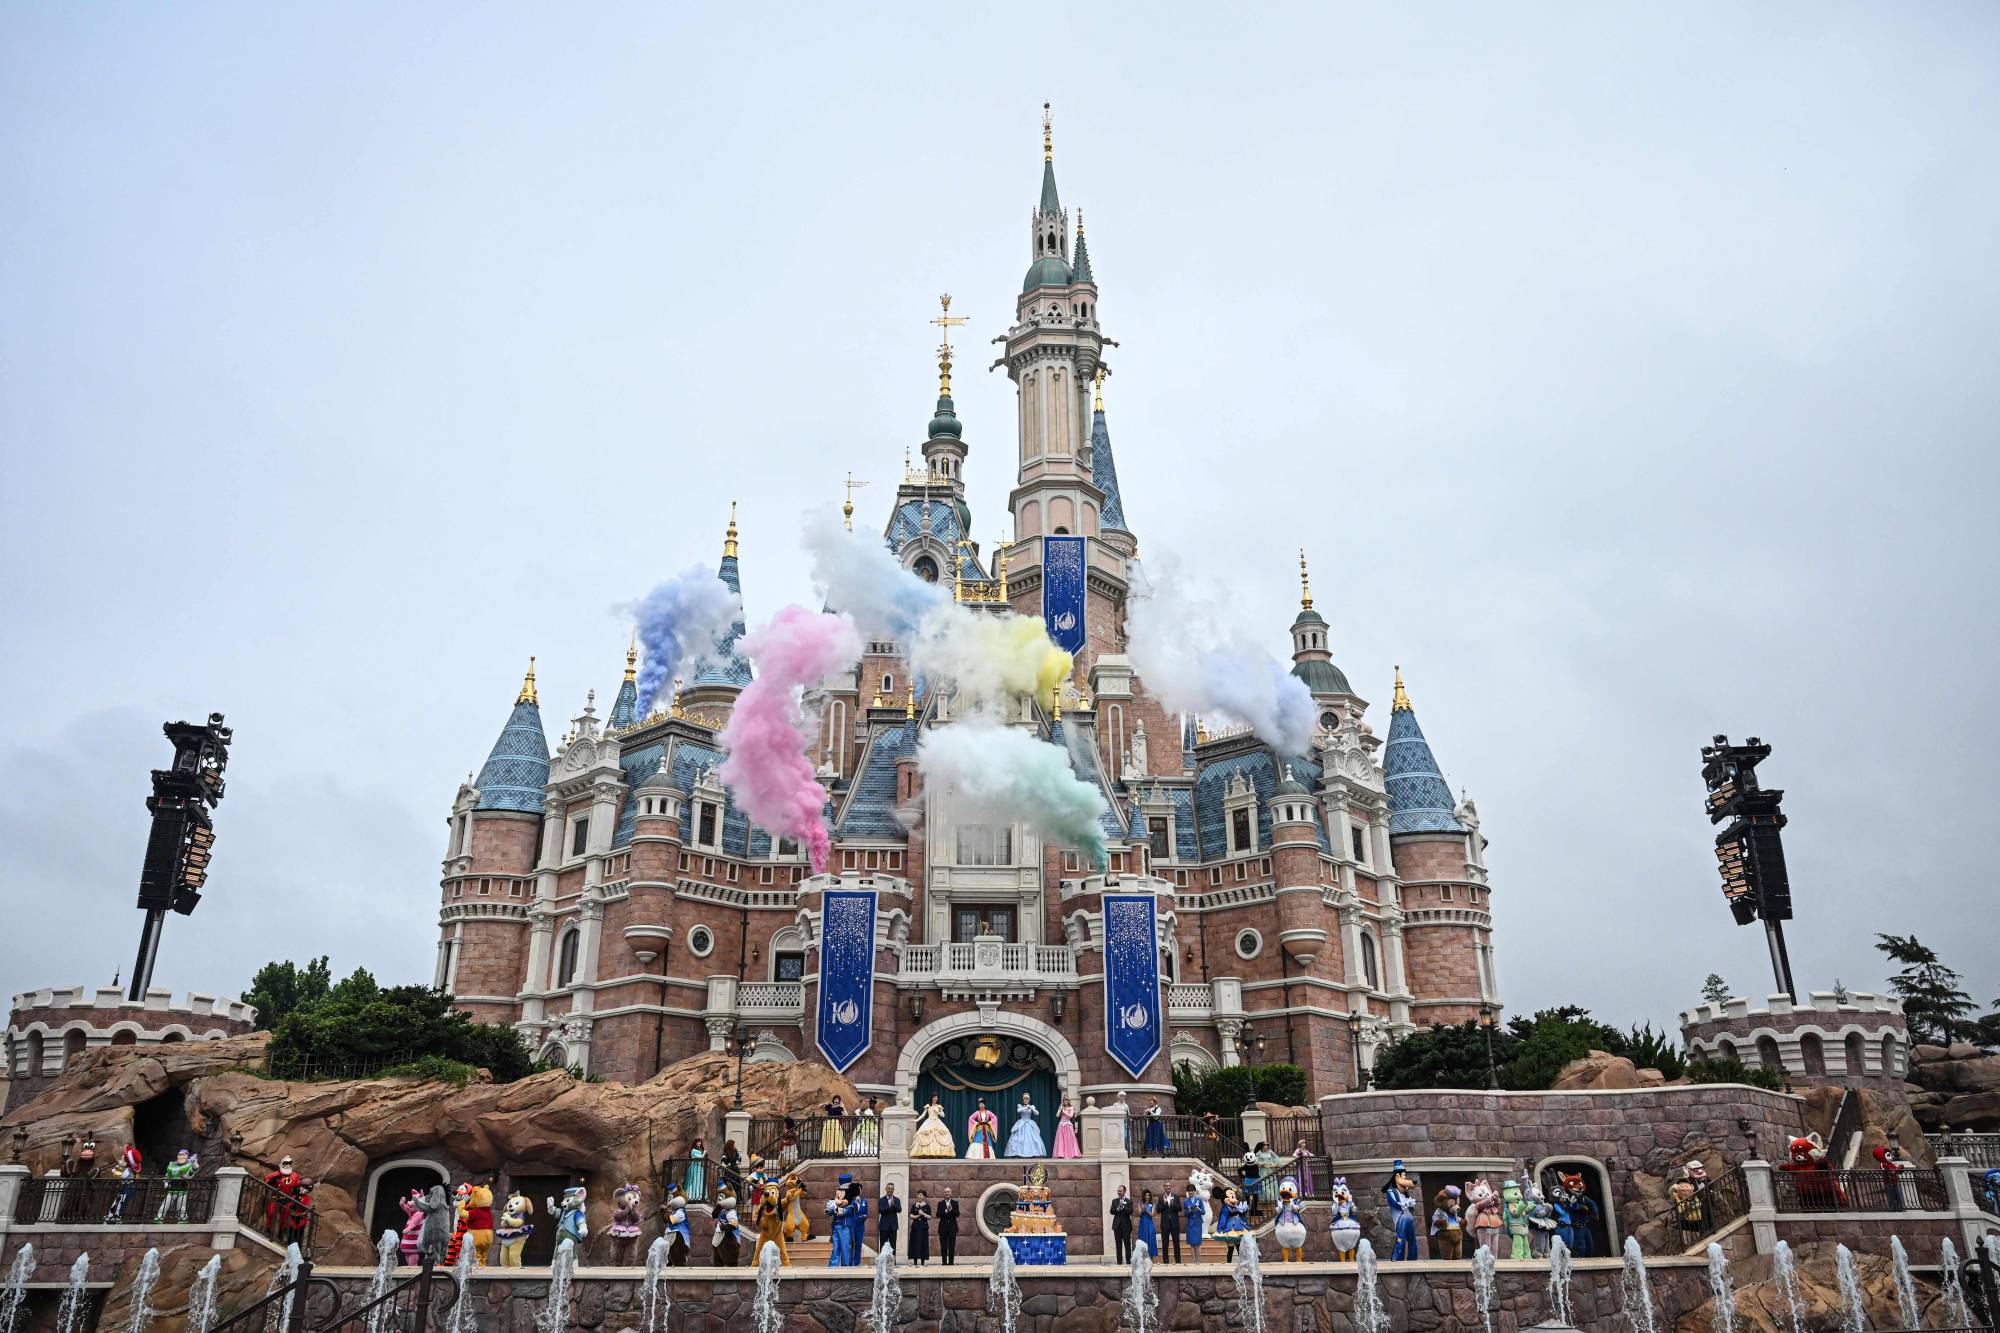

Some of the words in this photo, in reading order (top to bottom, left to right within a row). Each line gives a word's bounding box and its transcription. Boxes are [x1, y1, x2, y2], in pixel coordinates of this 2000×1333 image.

[1053, 612, 1076, 631] 10
[832, 999, 859, 1025] 10
[1120, 1004, 1148, 1029] 10
[1023, 1164, 1048, 1186] 10
